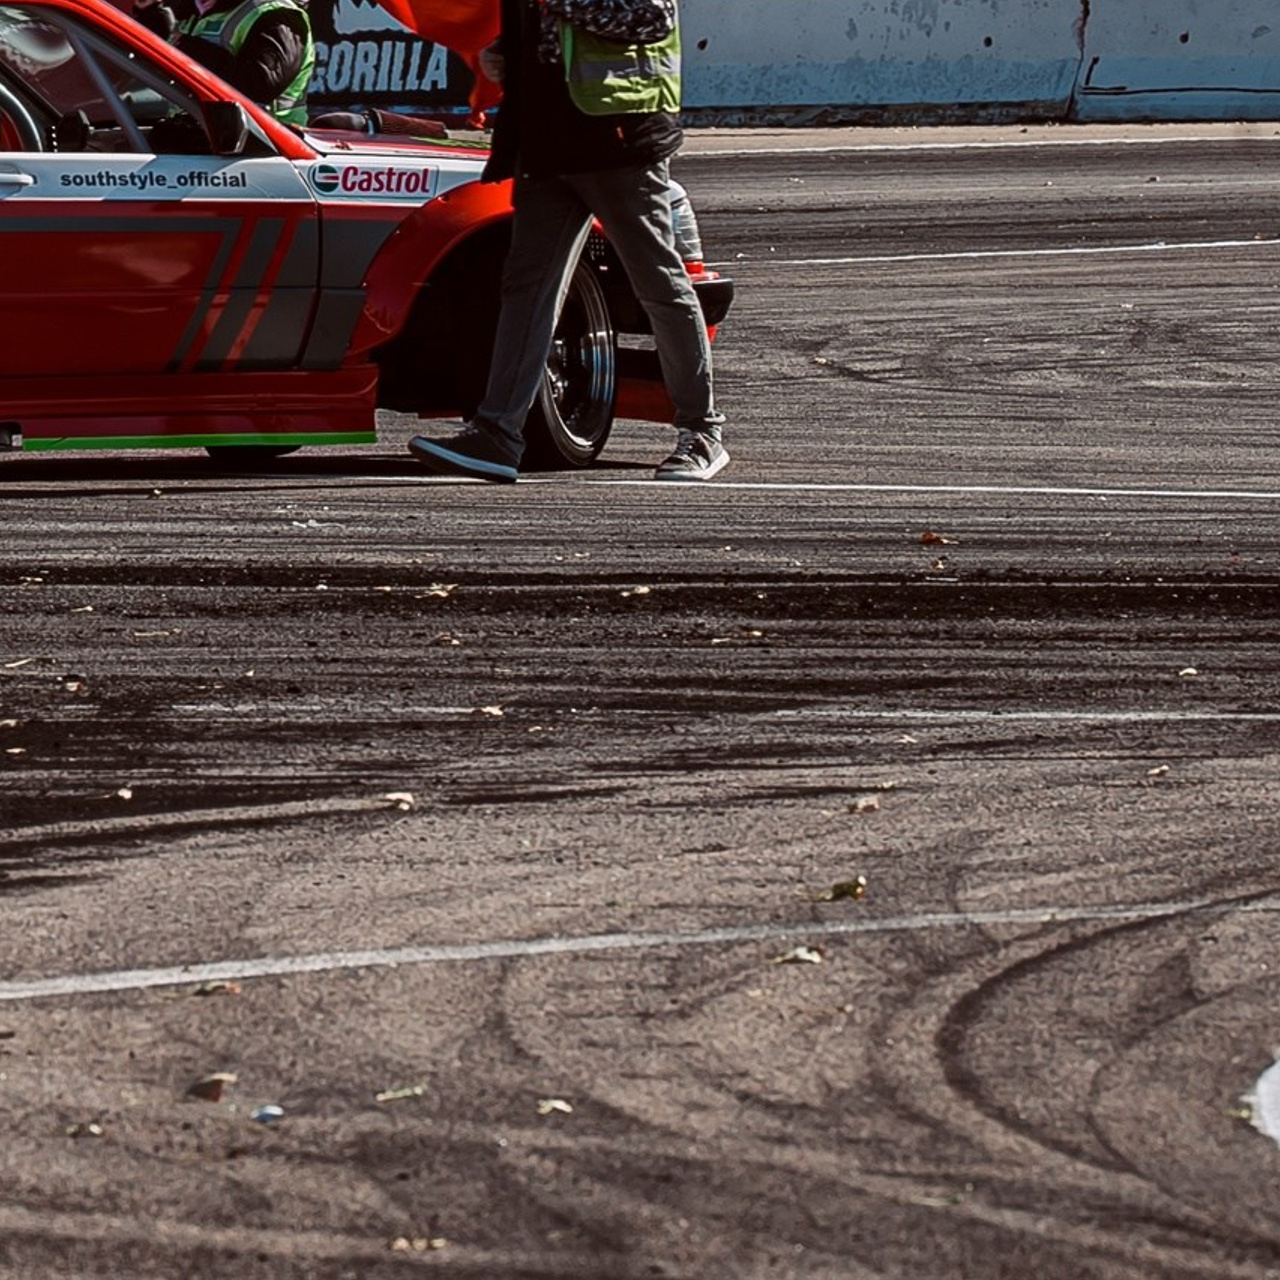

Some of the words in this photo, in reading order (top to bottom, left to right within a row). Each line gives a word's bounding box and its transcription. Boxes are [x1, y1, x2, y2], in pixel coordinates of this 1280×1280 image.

[307, 40, 448, 94] GORILLA
[60, 171, 247, 190] southstyle_official
[341, 165, 430, 193] Castrol
